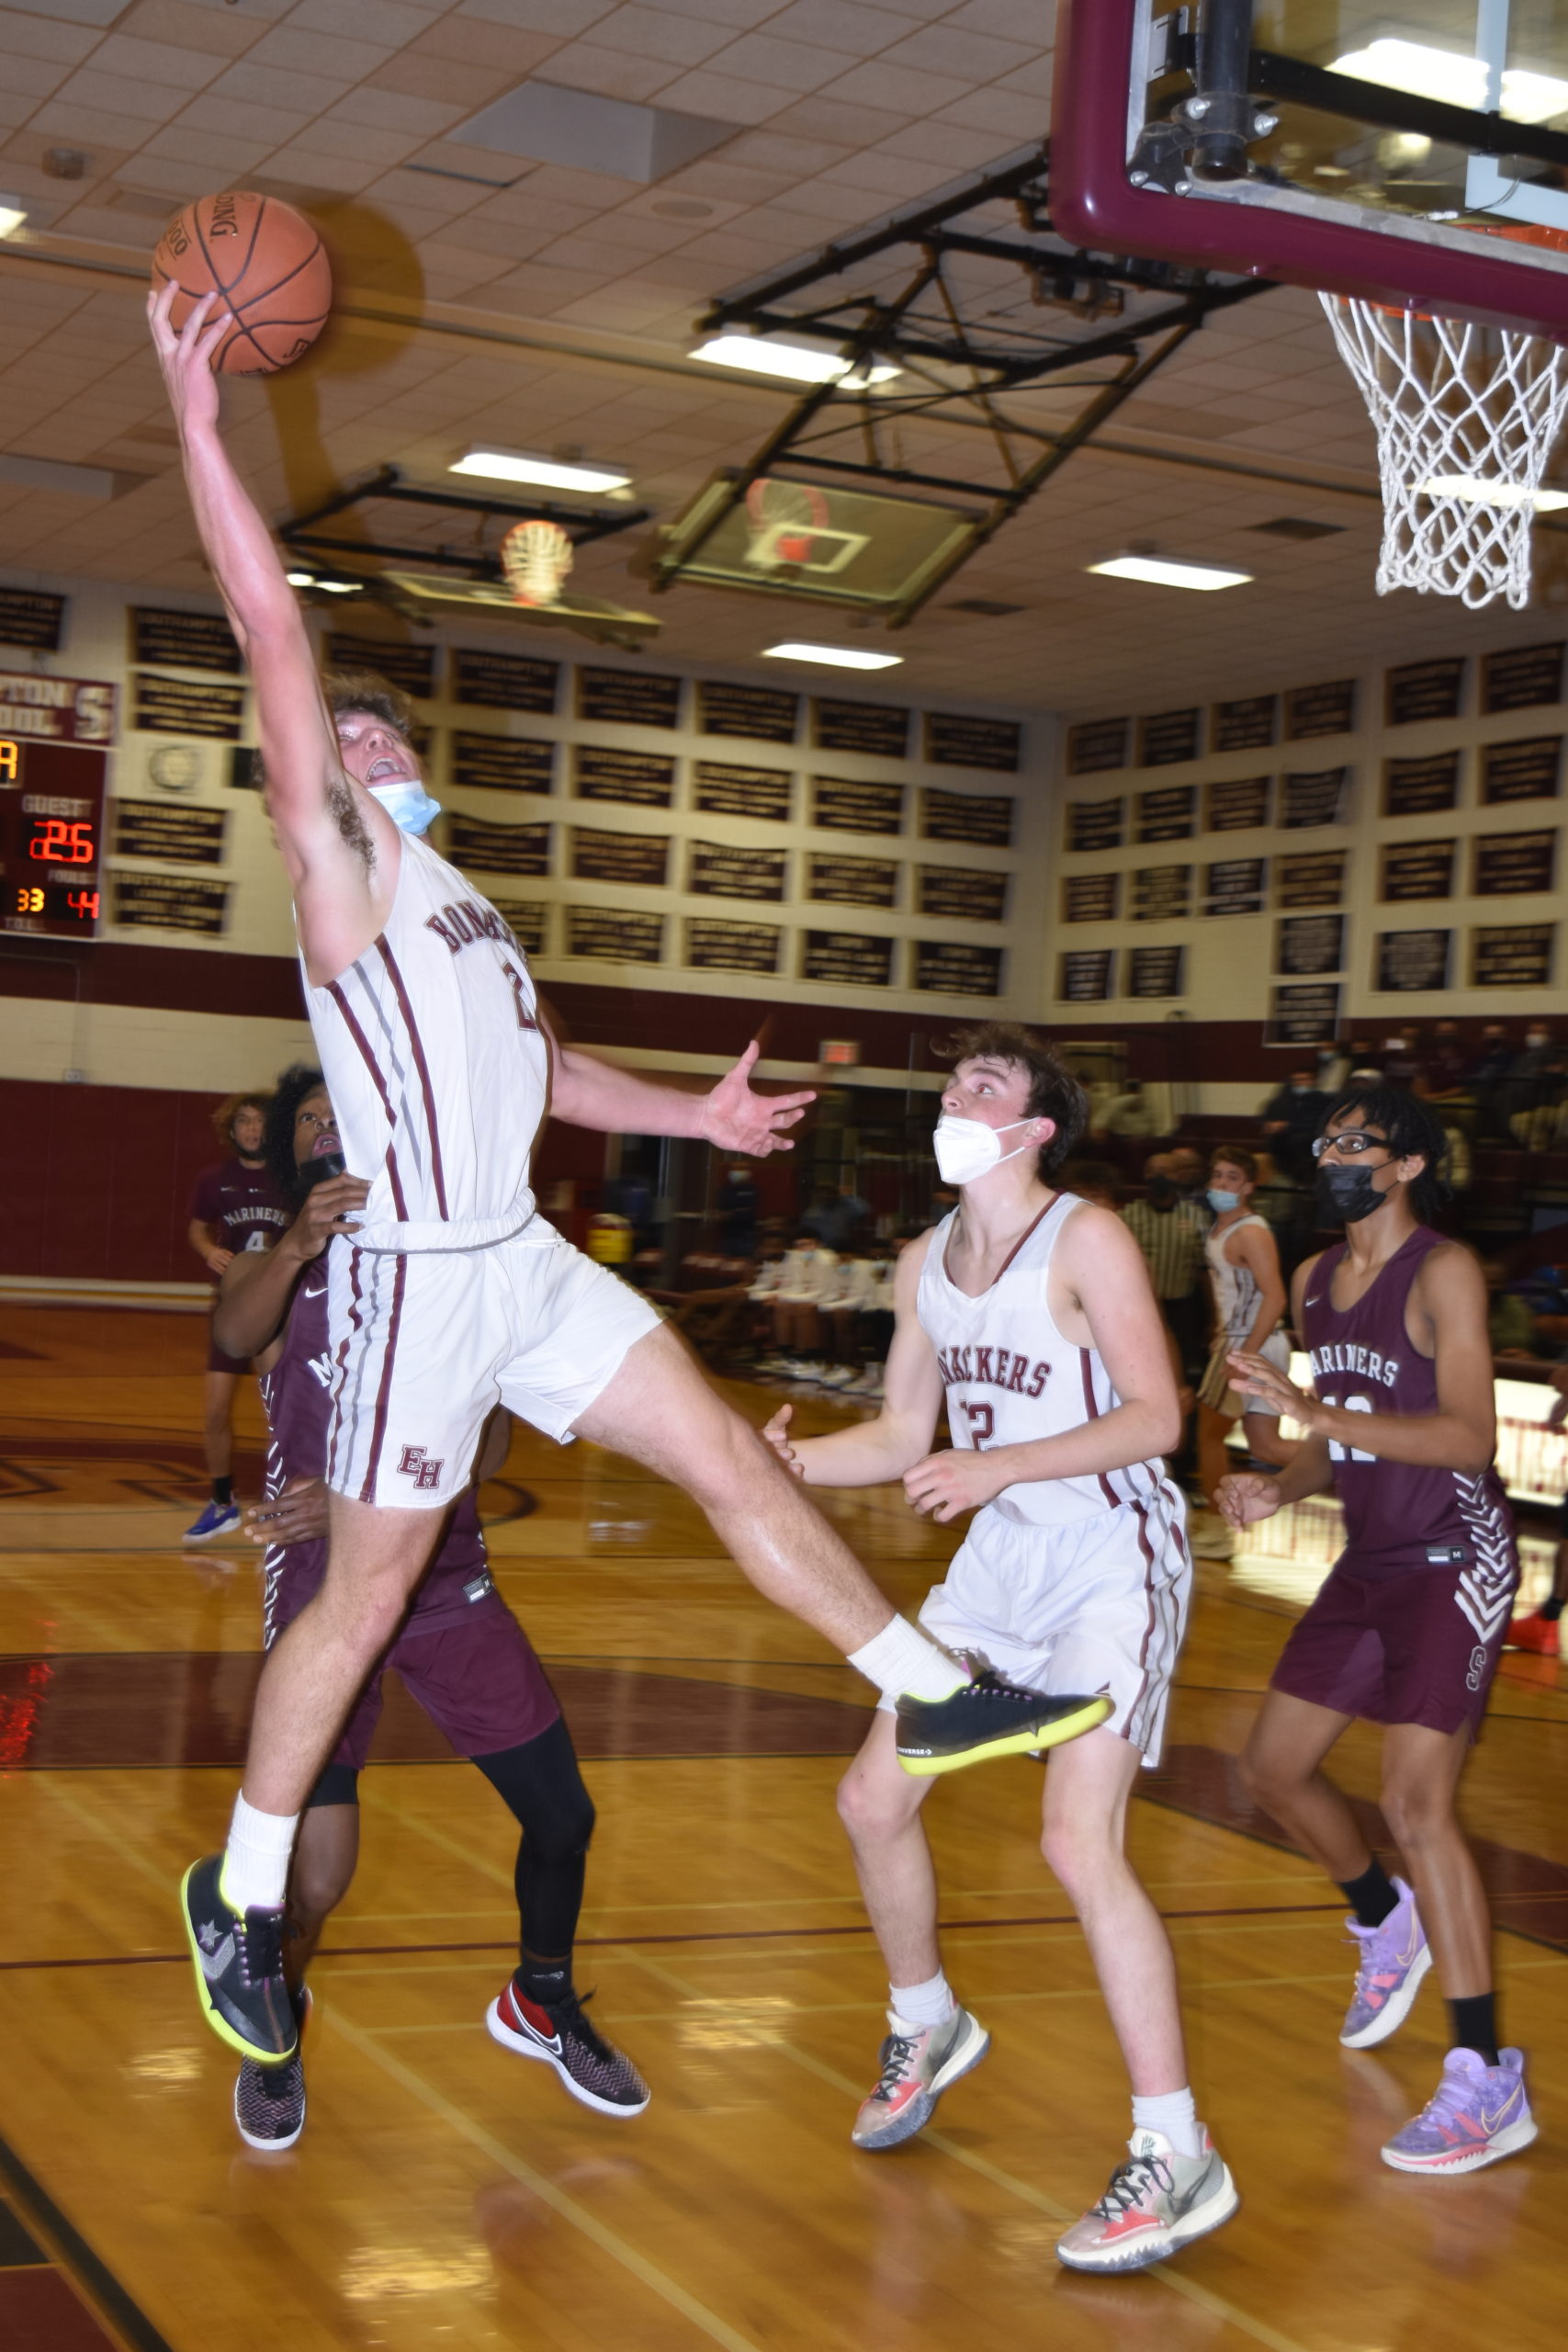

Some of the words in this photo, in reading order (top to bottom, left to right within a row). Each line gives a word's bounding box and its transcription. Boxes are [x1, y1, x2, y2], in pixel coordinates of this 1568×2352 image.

[22, 794, 88, 817] GUEST
[223, 1206, 286, 1227] MARINERS
[245, 1230, 265, 1251] 4
